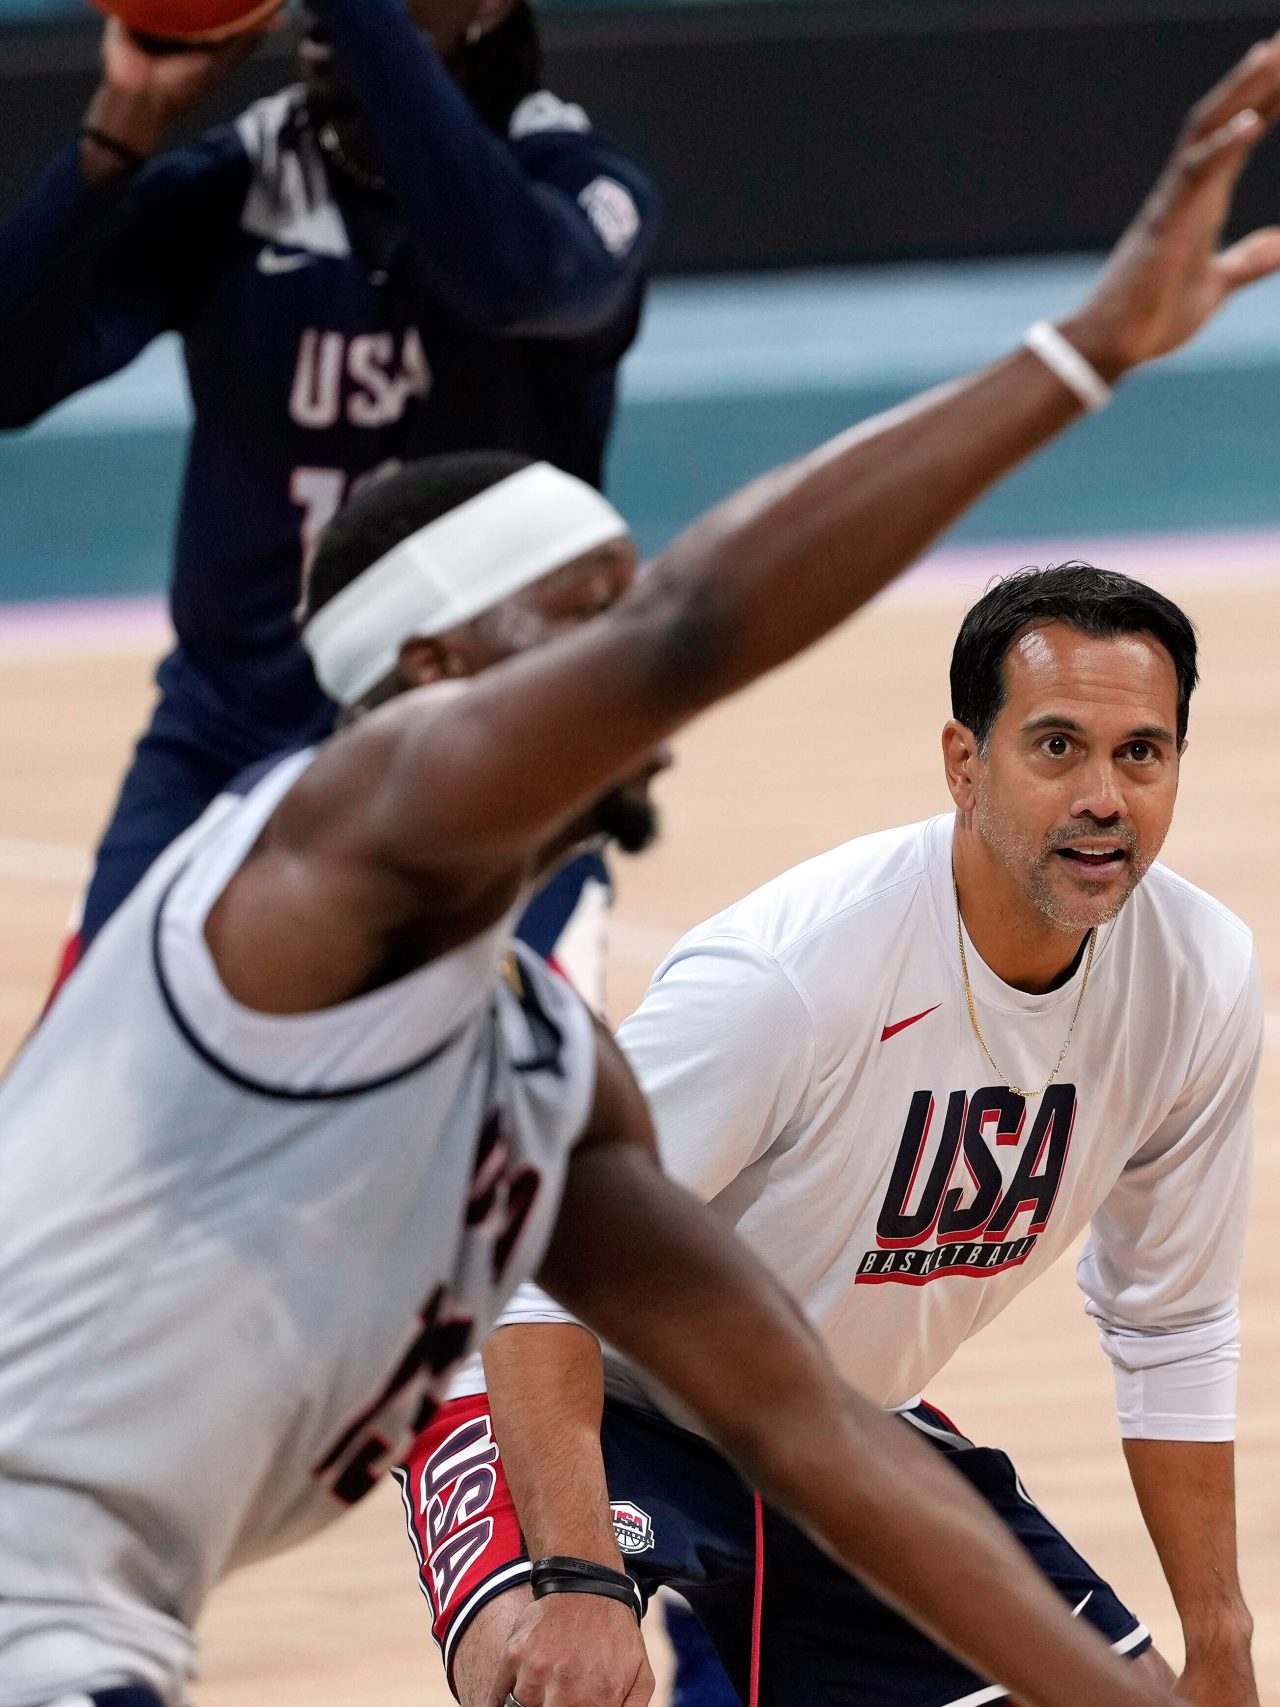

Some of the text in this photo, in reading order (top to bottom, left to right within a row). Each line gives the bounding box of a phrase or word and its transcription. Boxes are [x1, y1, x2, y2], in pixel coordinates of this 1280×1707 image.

[876, 1083, 1077, 1249] USA
[861, 1238, 1031, 1275] BASKETBALL
[420, 1415, 500, 1616] USA
